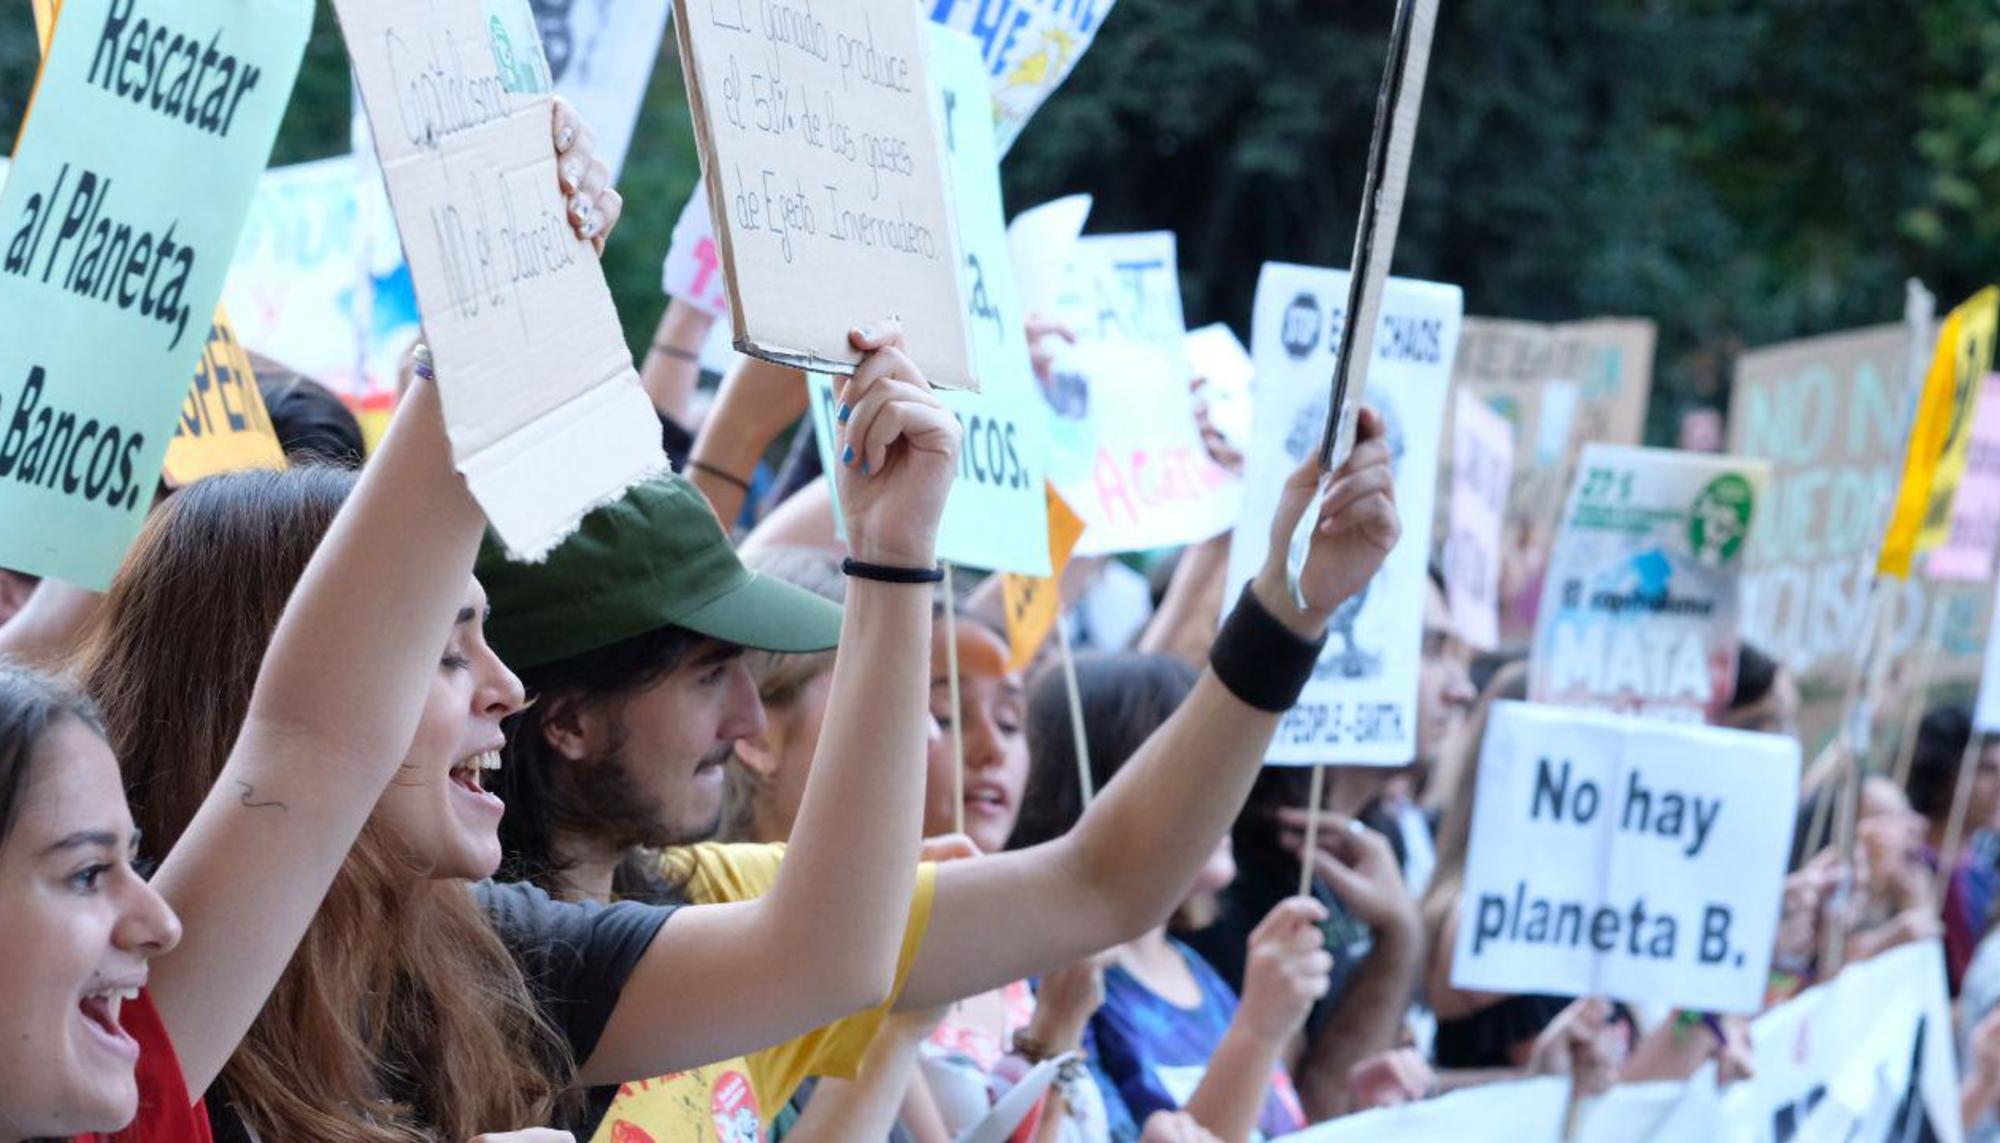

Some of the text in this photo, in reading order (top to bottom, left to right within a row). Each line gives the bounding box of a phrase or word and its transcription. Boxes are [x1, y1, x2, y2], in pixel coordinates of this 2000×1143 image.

[87, 0, 260, 137] Rescatar
[837, 10, 912, 92] produce
[723, 53, 746, 130] el
[802, 84, 824, 148] de
[824, 89, 856, 162] los
[862, 132, 913, 201] gases
[736, 164, 760, 230] de
[3, 163, 68, 277] al
[42, 170, 196, 351] Planeta,
[0, 365, 144, 511] Bancos.
[1530, 757, 1722, 859] No hay
[1472, 877, 1748, 968] planeta B.
